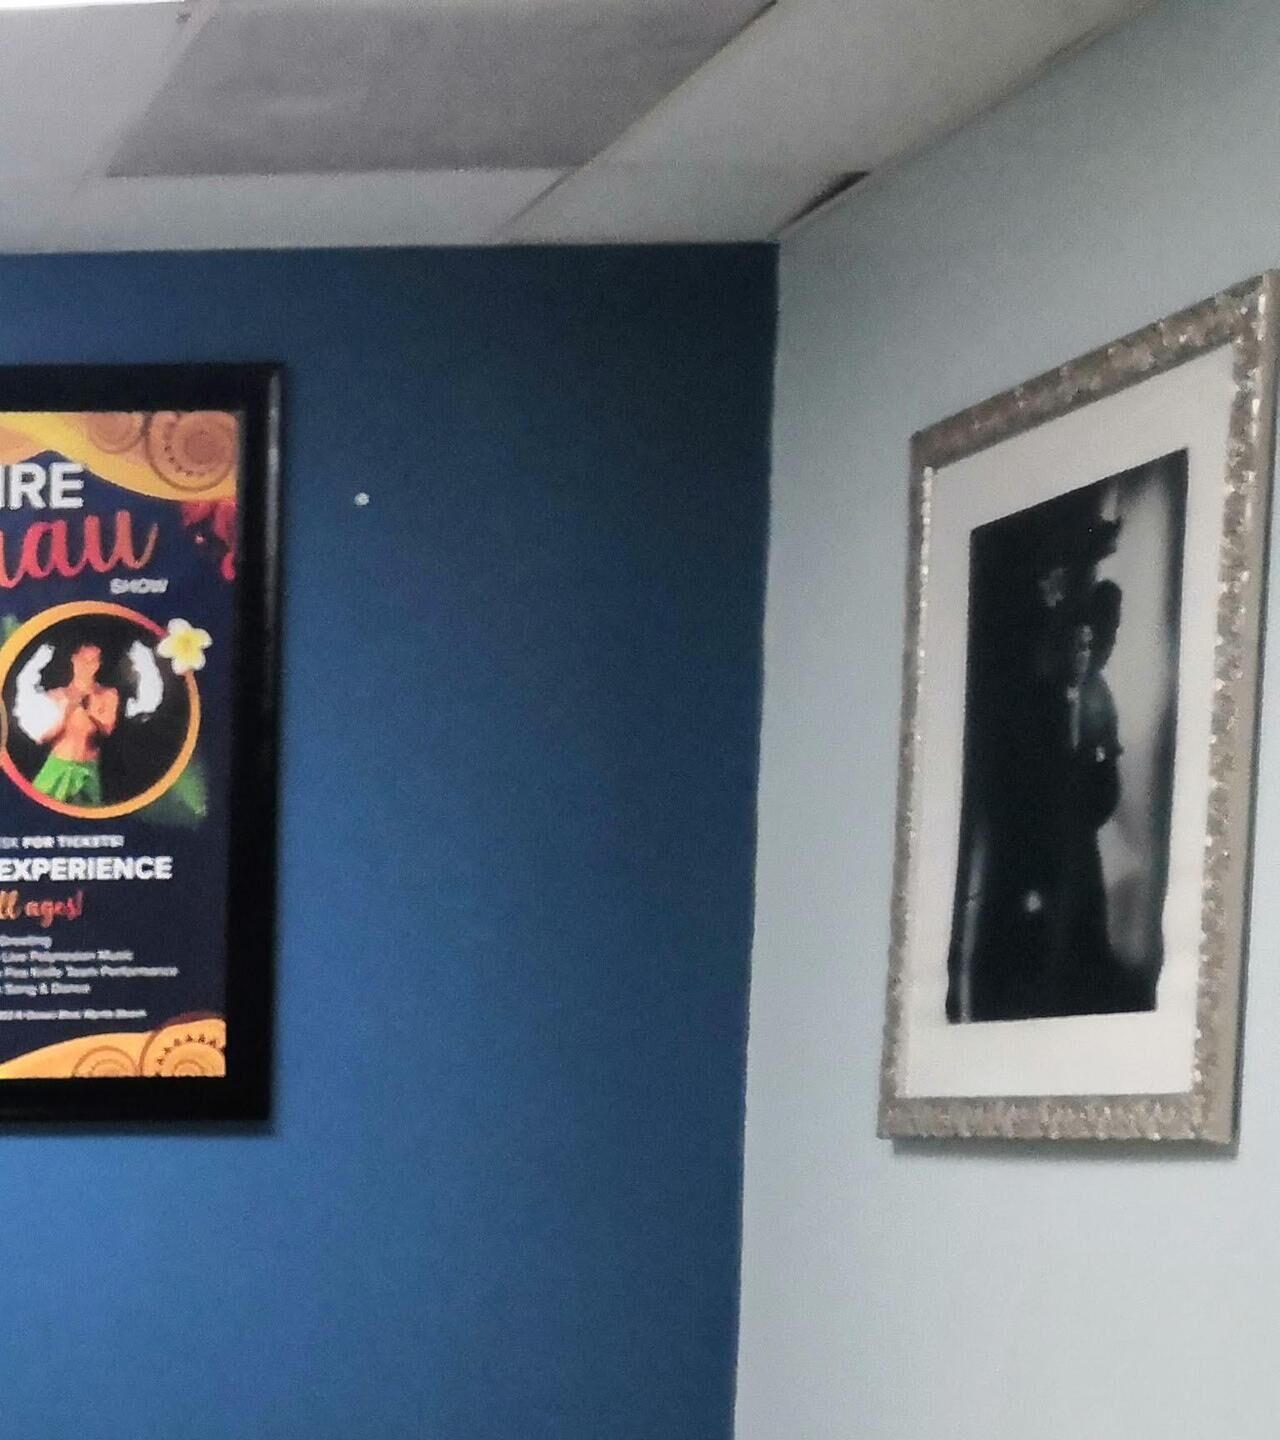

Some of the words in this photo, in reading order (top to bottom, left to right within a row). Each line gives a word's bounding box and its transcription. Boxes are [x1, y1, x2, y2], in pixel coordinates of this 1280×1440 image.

[109, 577, 169, 595] SHOW
[22, 835, 55, 849] FOR
[56, 834, 126, 849] TICKETS!
[24, 888, 84, 929] ages!
